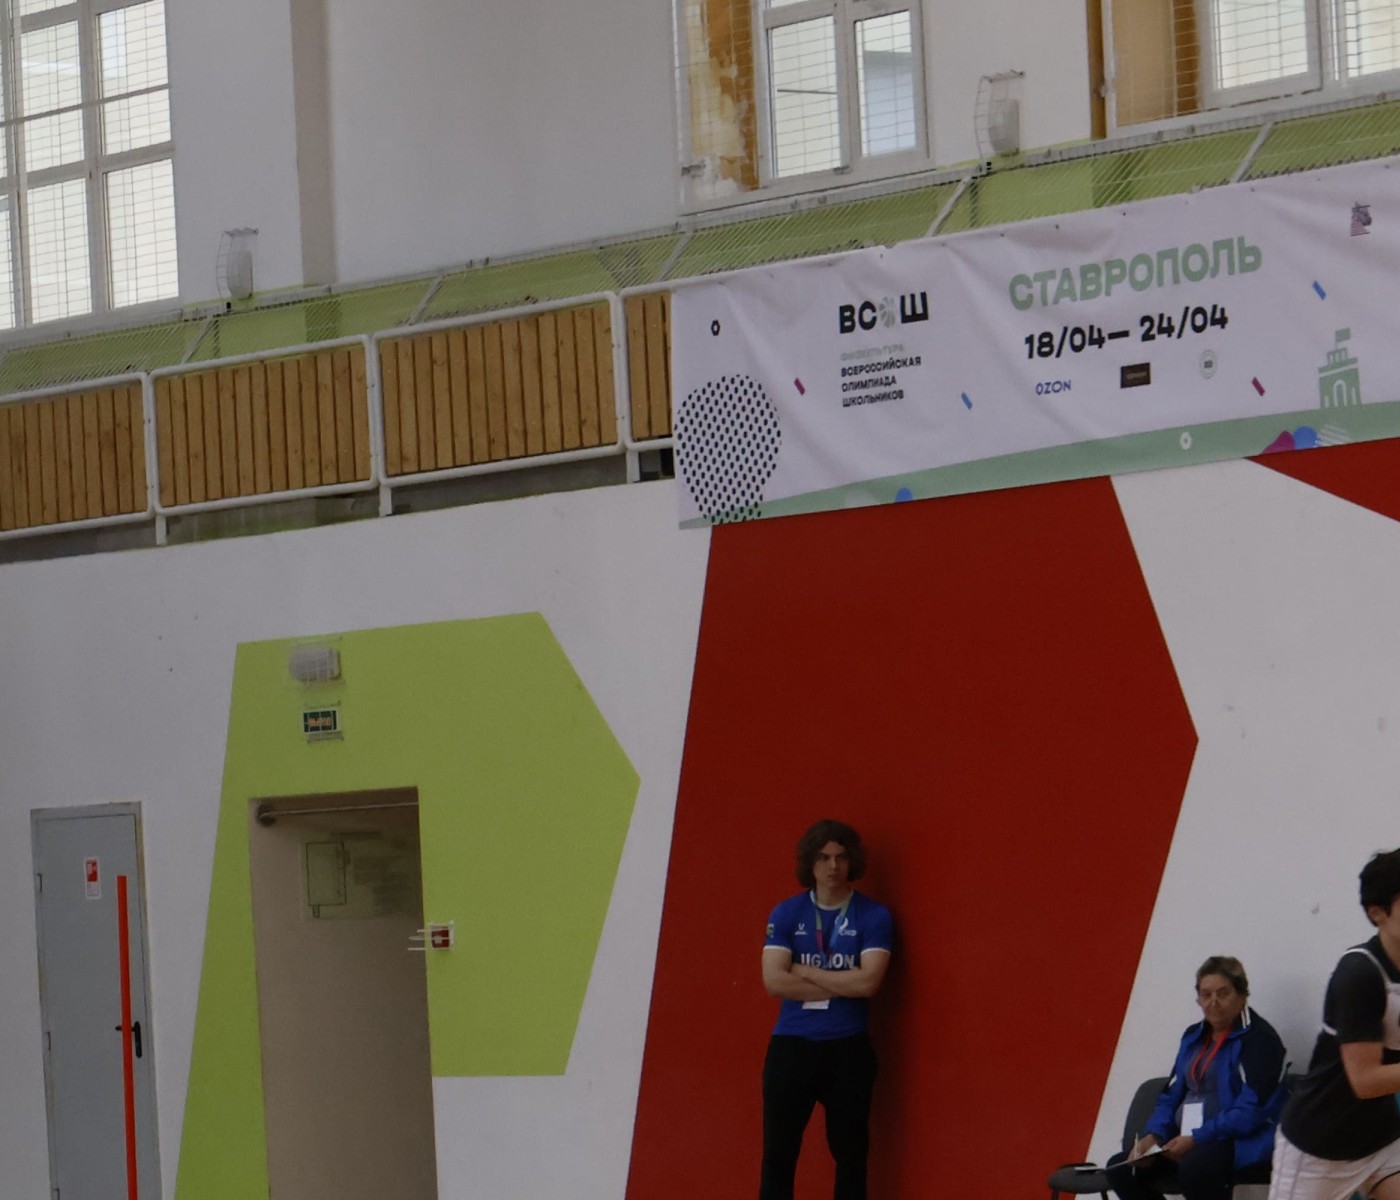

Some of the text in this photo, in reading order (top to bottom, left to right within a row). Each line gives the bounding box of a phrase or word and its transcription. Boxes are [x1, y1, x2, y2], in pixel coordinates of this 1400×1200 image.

[1009, 236, 1262, 311] СТАВРОПОЛЬ
[1140, 304, 1228, 342] 24/04
[841, 356, 922, 377] ВСЕРОССИЙСКАЯ
[841, 375, 897, 392] ОЛИМПИАДА
[1035, 380, 1072, 396] OZON
[842, 389, 904, 408] ШКОЛЬНИКОВ
